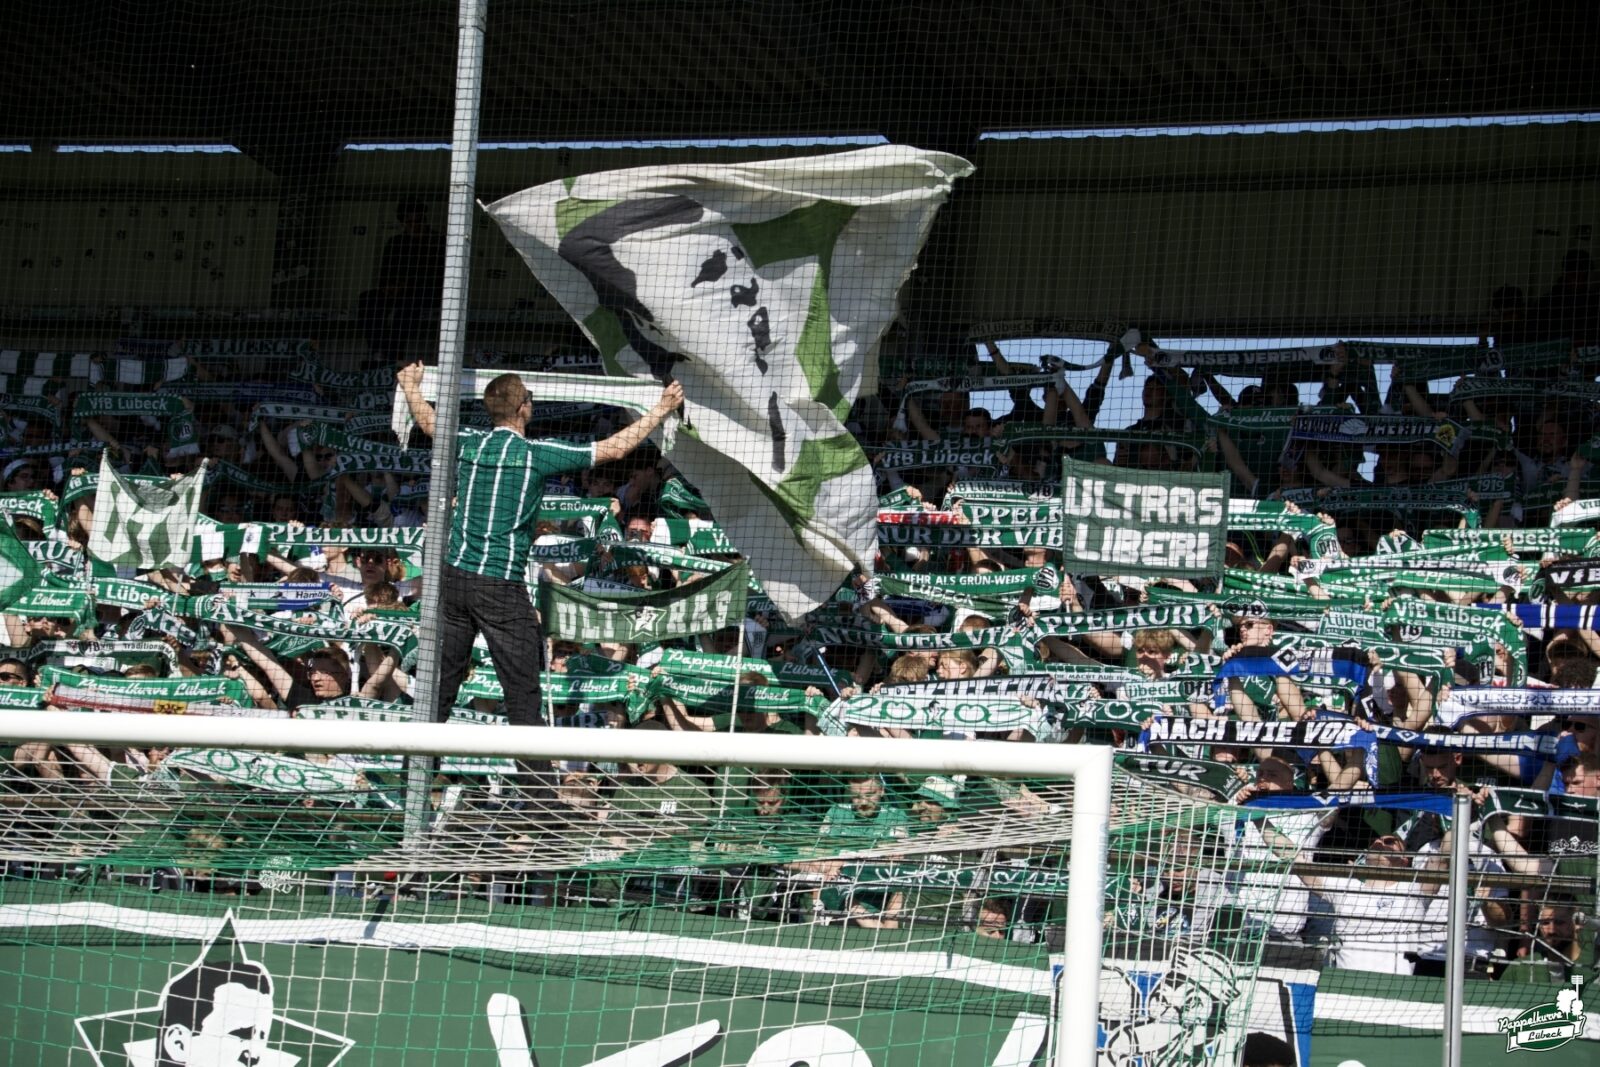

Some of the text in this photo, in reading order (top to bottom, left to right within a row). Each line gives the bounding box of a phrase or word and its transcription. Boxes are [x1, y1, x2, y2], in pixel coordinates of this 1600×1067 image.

[88, 395, 168, 412] VfB Lübeck
[881, 448, 995, 468] VfB Lübeck
[1064, 476, 1224, 526] ULTRAS
[941, 526, 1001, 545] DER
[1014, 526, 1063, 547] VfB
[1074, 523, 1210, 569] LIBERI
[1488, 529, 1561, 547] Lbeck
[901, 573, 931, 584] MEHR
[935, 575, 956, 586] ALS
[960, 572, 1026, 586] GRÜN-WEISS
[1394, 601, 1505, 631] VfB Lübeck
[173, 680, 226, 697] Lübeck
[1150, 718, 1360, 745] NACH WIE VOR
